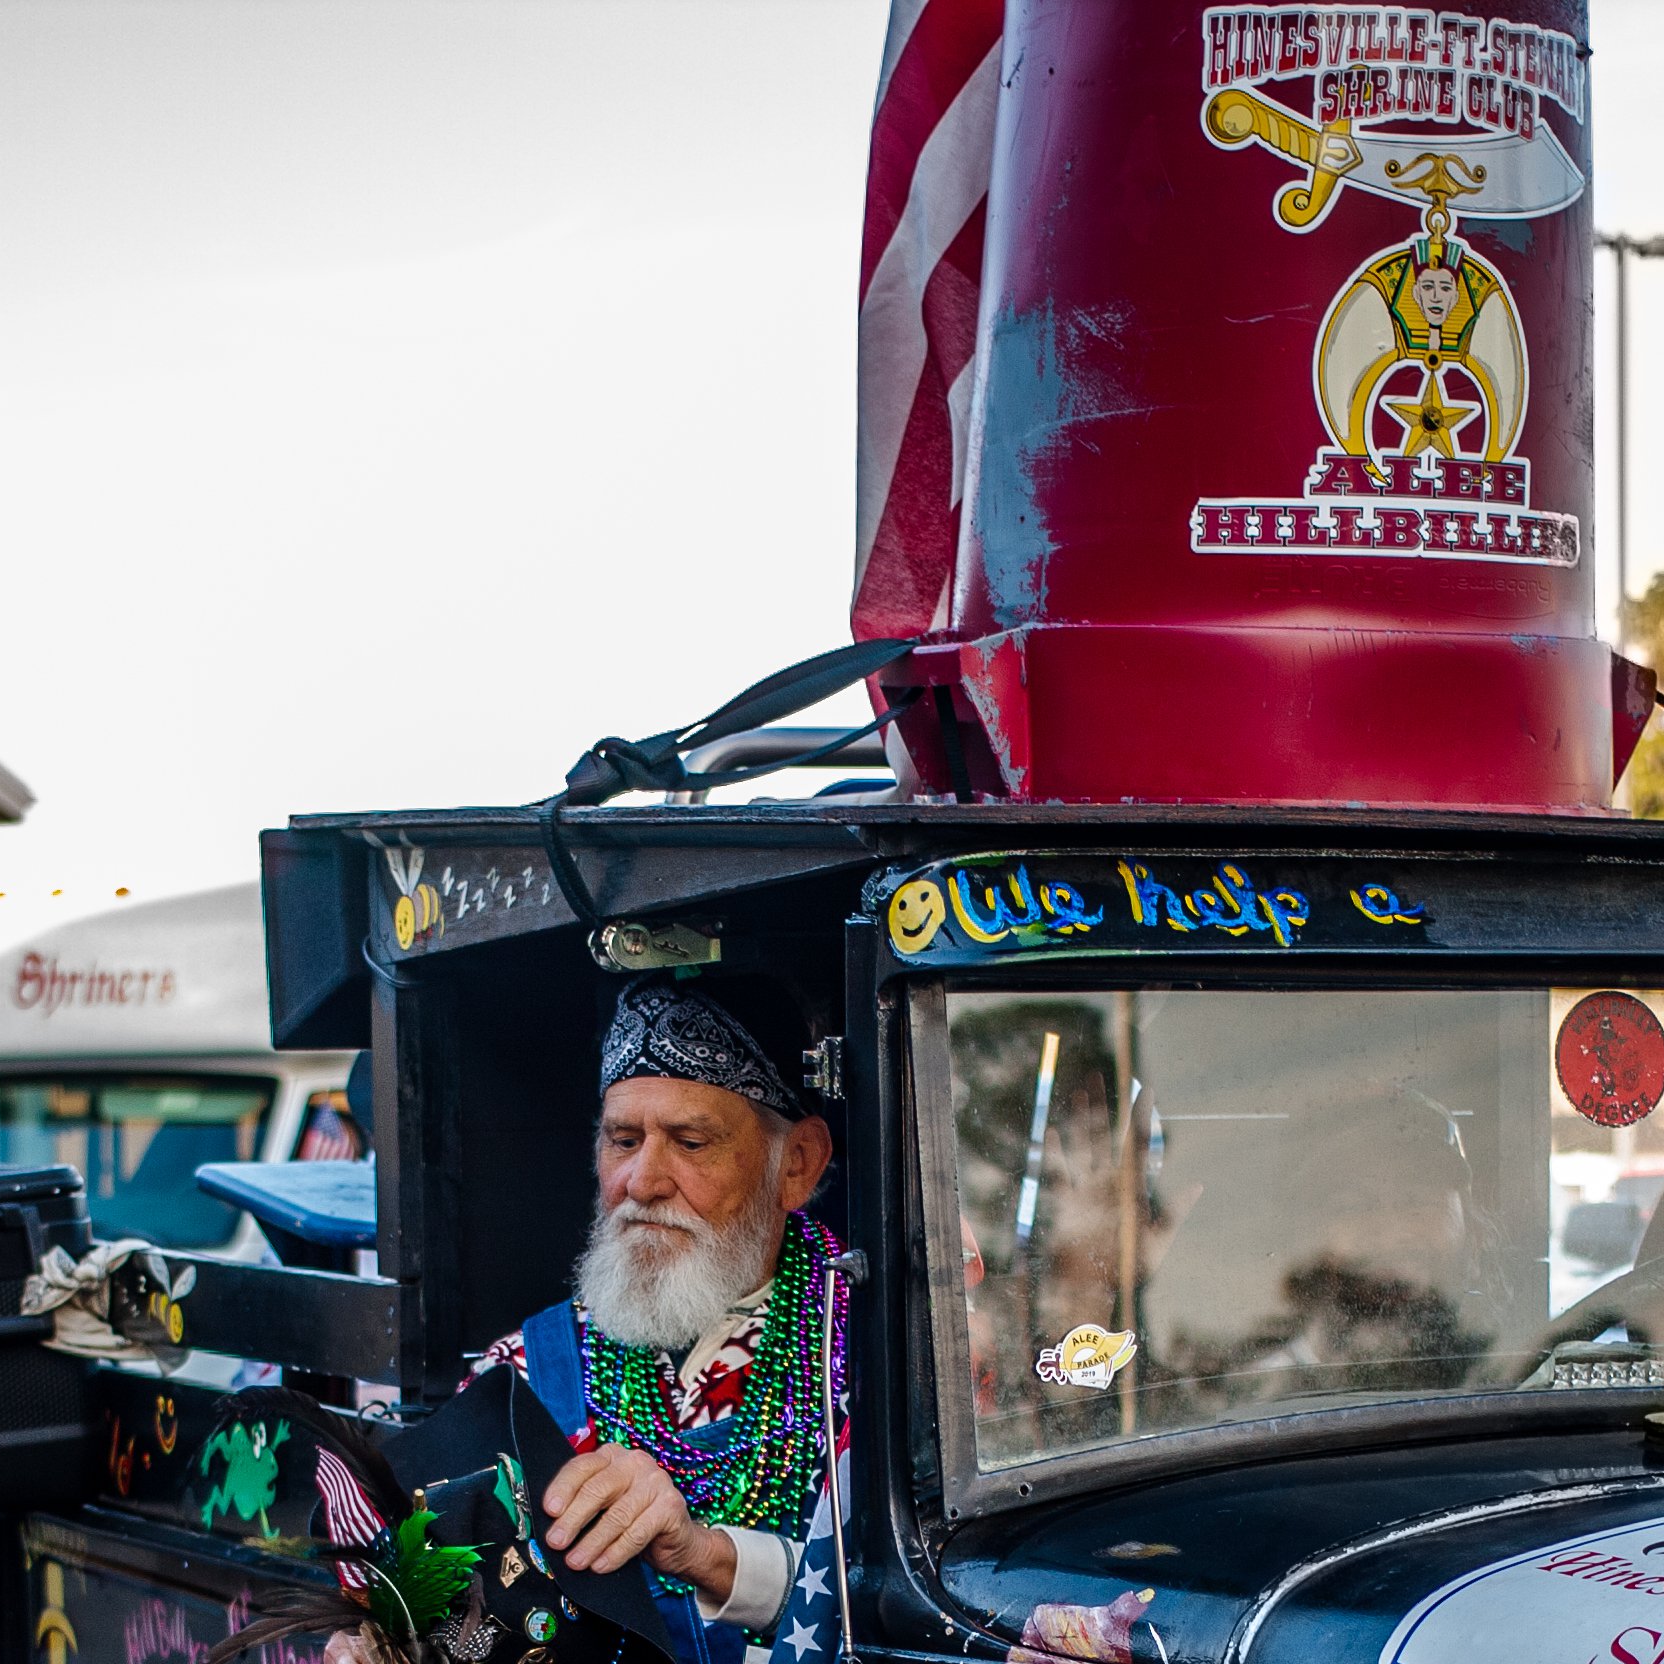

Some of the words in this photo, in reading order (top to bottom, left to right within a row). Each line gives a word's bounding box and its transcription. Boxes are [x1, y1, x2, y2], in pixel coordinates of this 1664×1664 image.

[1319, 67, 1455, 125] SHRINE
[1466, 75, 1537, 143] CLUB
[1309, 454, 1526, 503] ALEE
[947, 862, 1105, 944] We
[1117, 857, 1310, 948] help
[1349, 882, 1425, 925] a
[1071, 1333, 1099, 1347] ALEE
